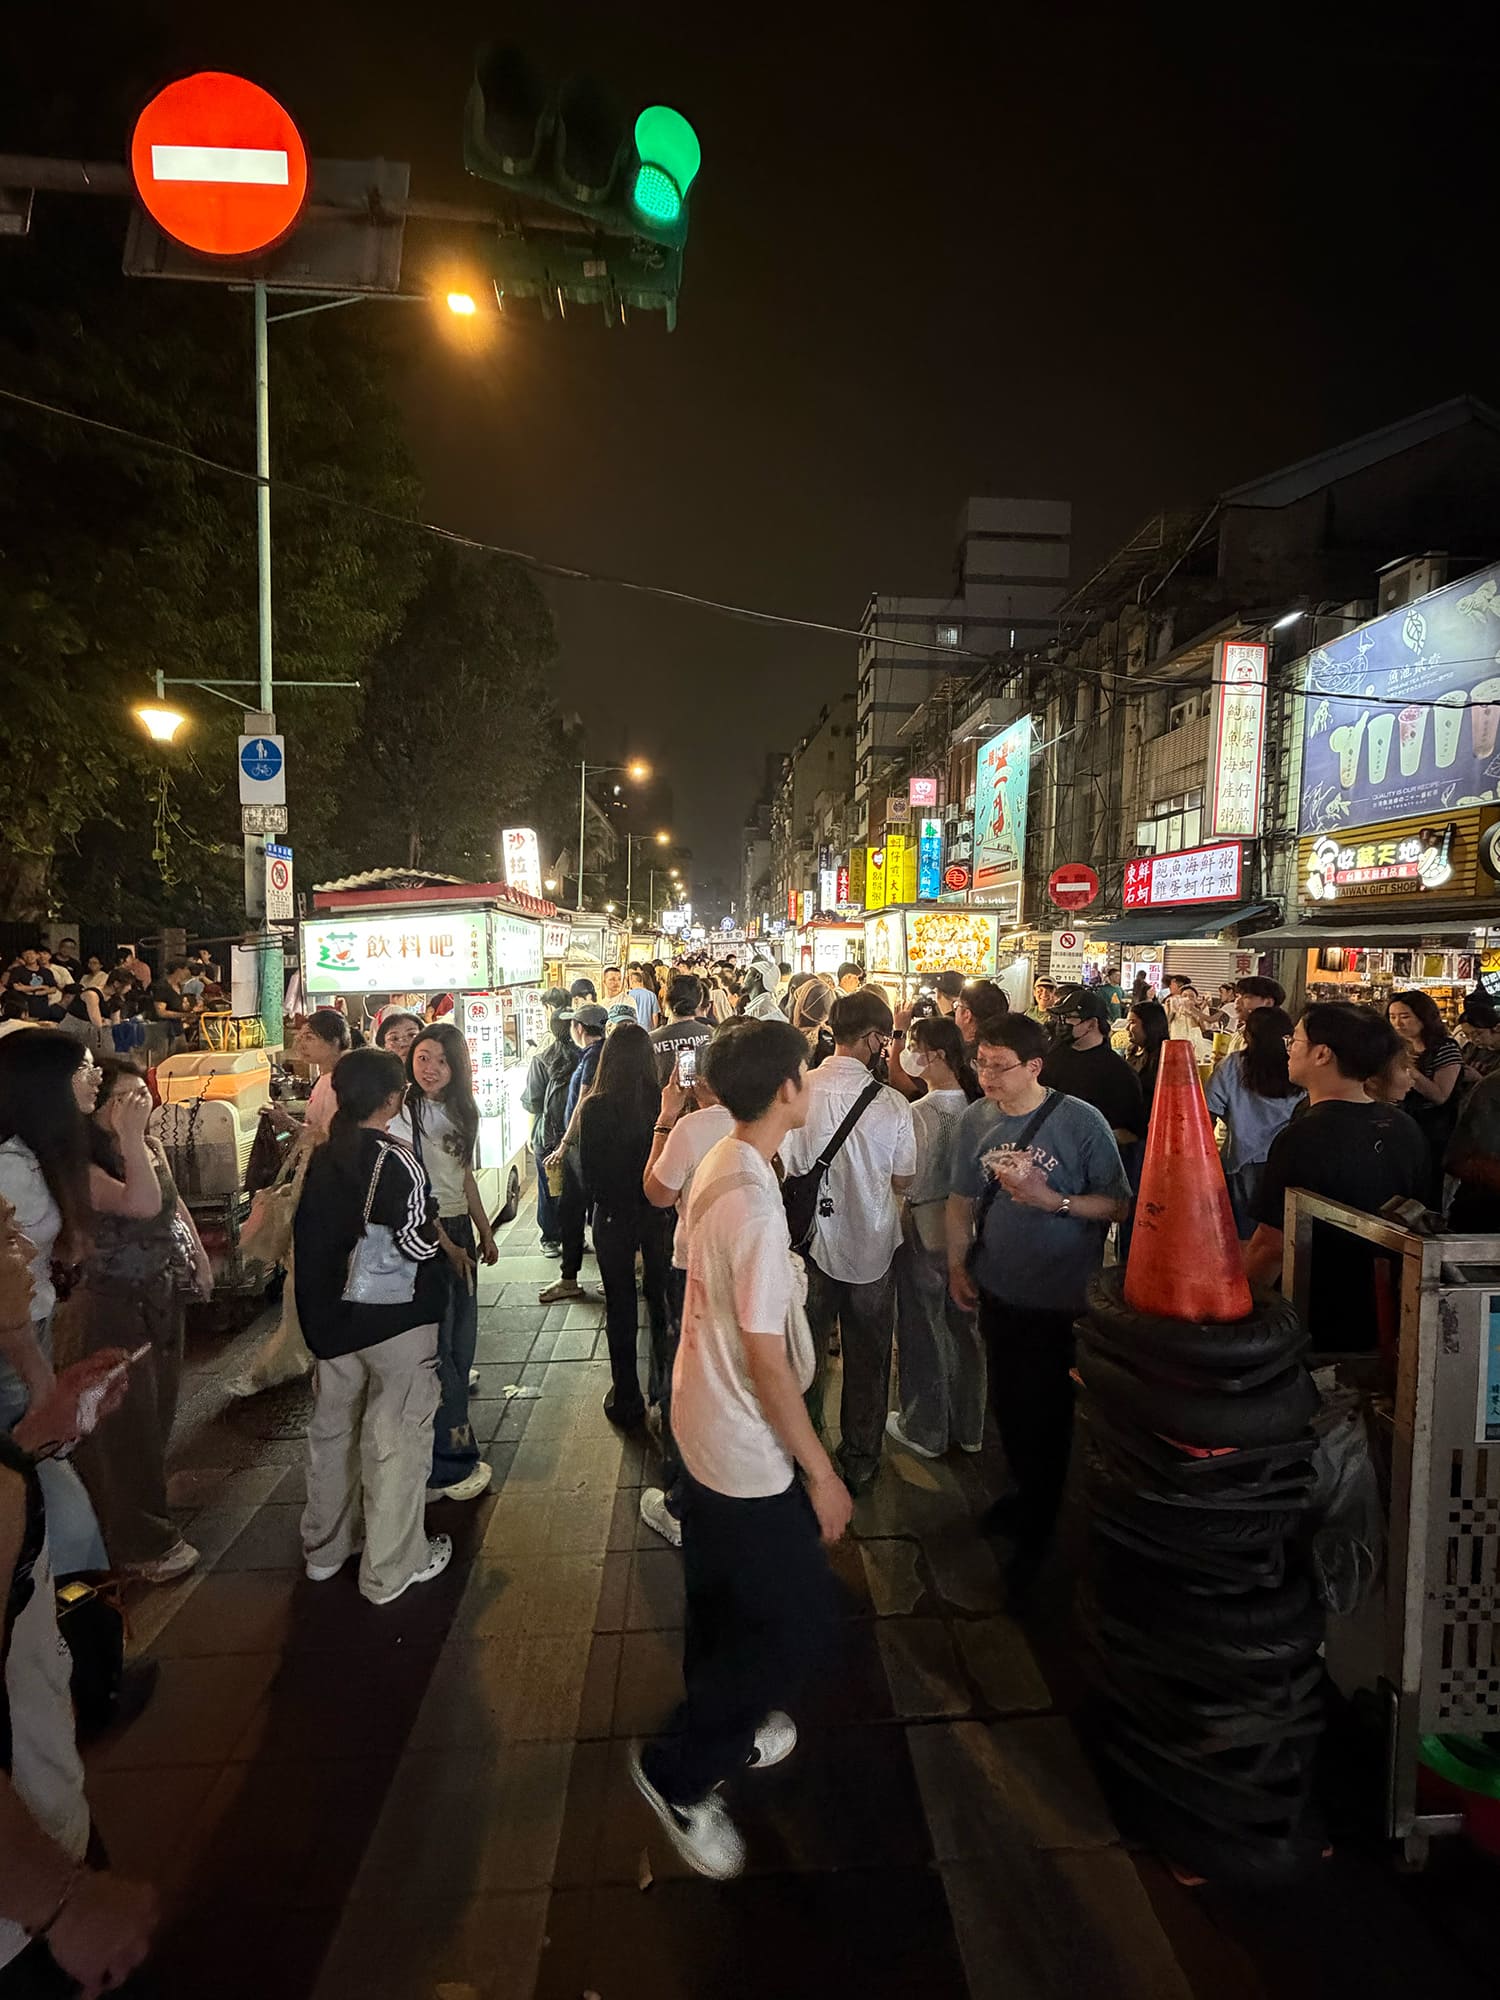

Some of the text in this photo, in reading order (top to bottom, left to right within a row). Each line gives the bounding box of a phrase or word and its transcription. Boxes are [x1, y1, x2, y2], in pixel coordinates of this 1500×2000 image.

[1235, 704, 1257, 826] 雞蛋蚵仔煎
[1153, 850, 1234, 880] 鮑魚海鮮粥
[1153, 872, 1233, 900] 雞蛋蚵仔煎
[1369, 884, 1388, 895] GIFT
[1390, 881, 1417, 892] SHOP
[366, 933, 456, 959] 飲料吧
[471, 1005, 485, 1018] 熱
[480, 1025, 493, 1096] 甘蔗汁
